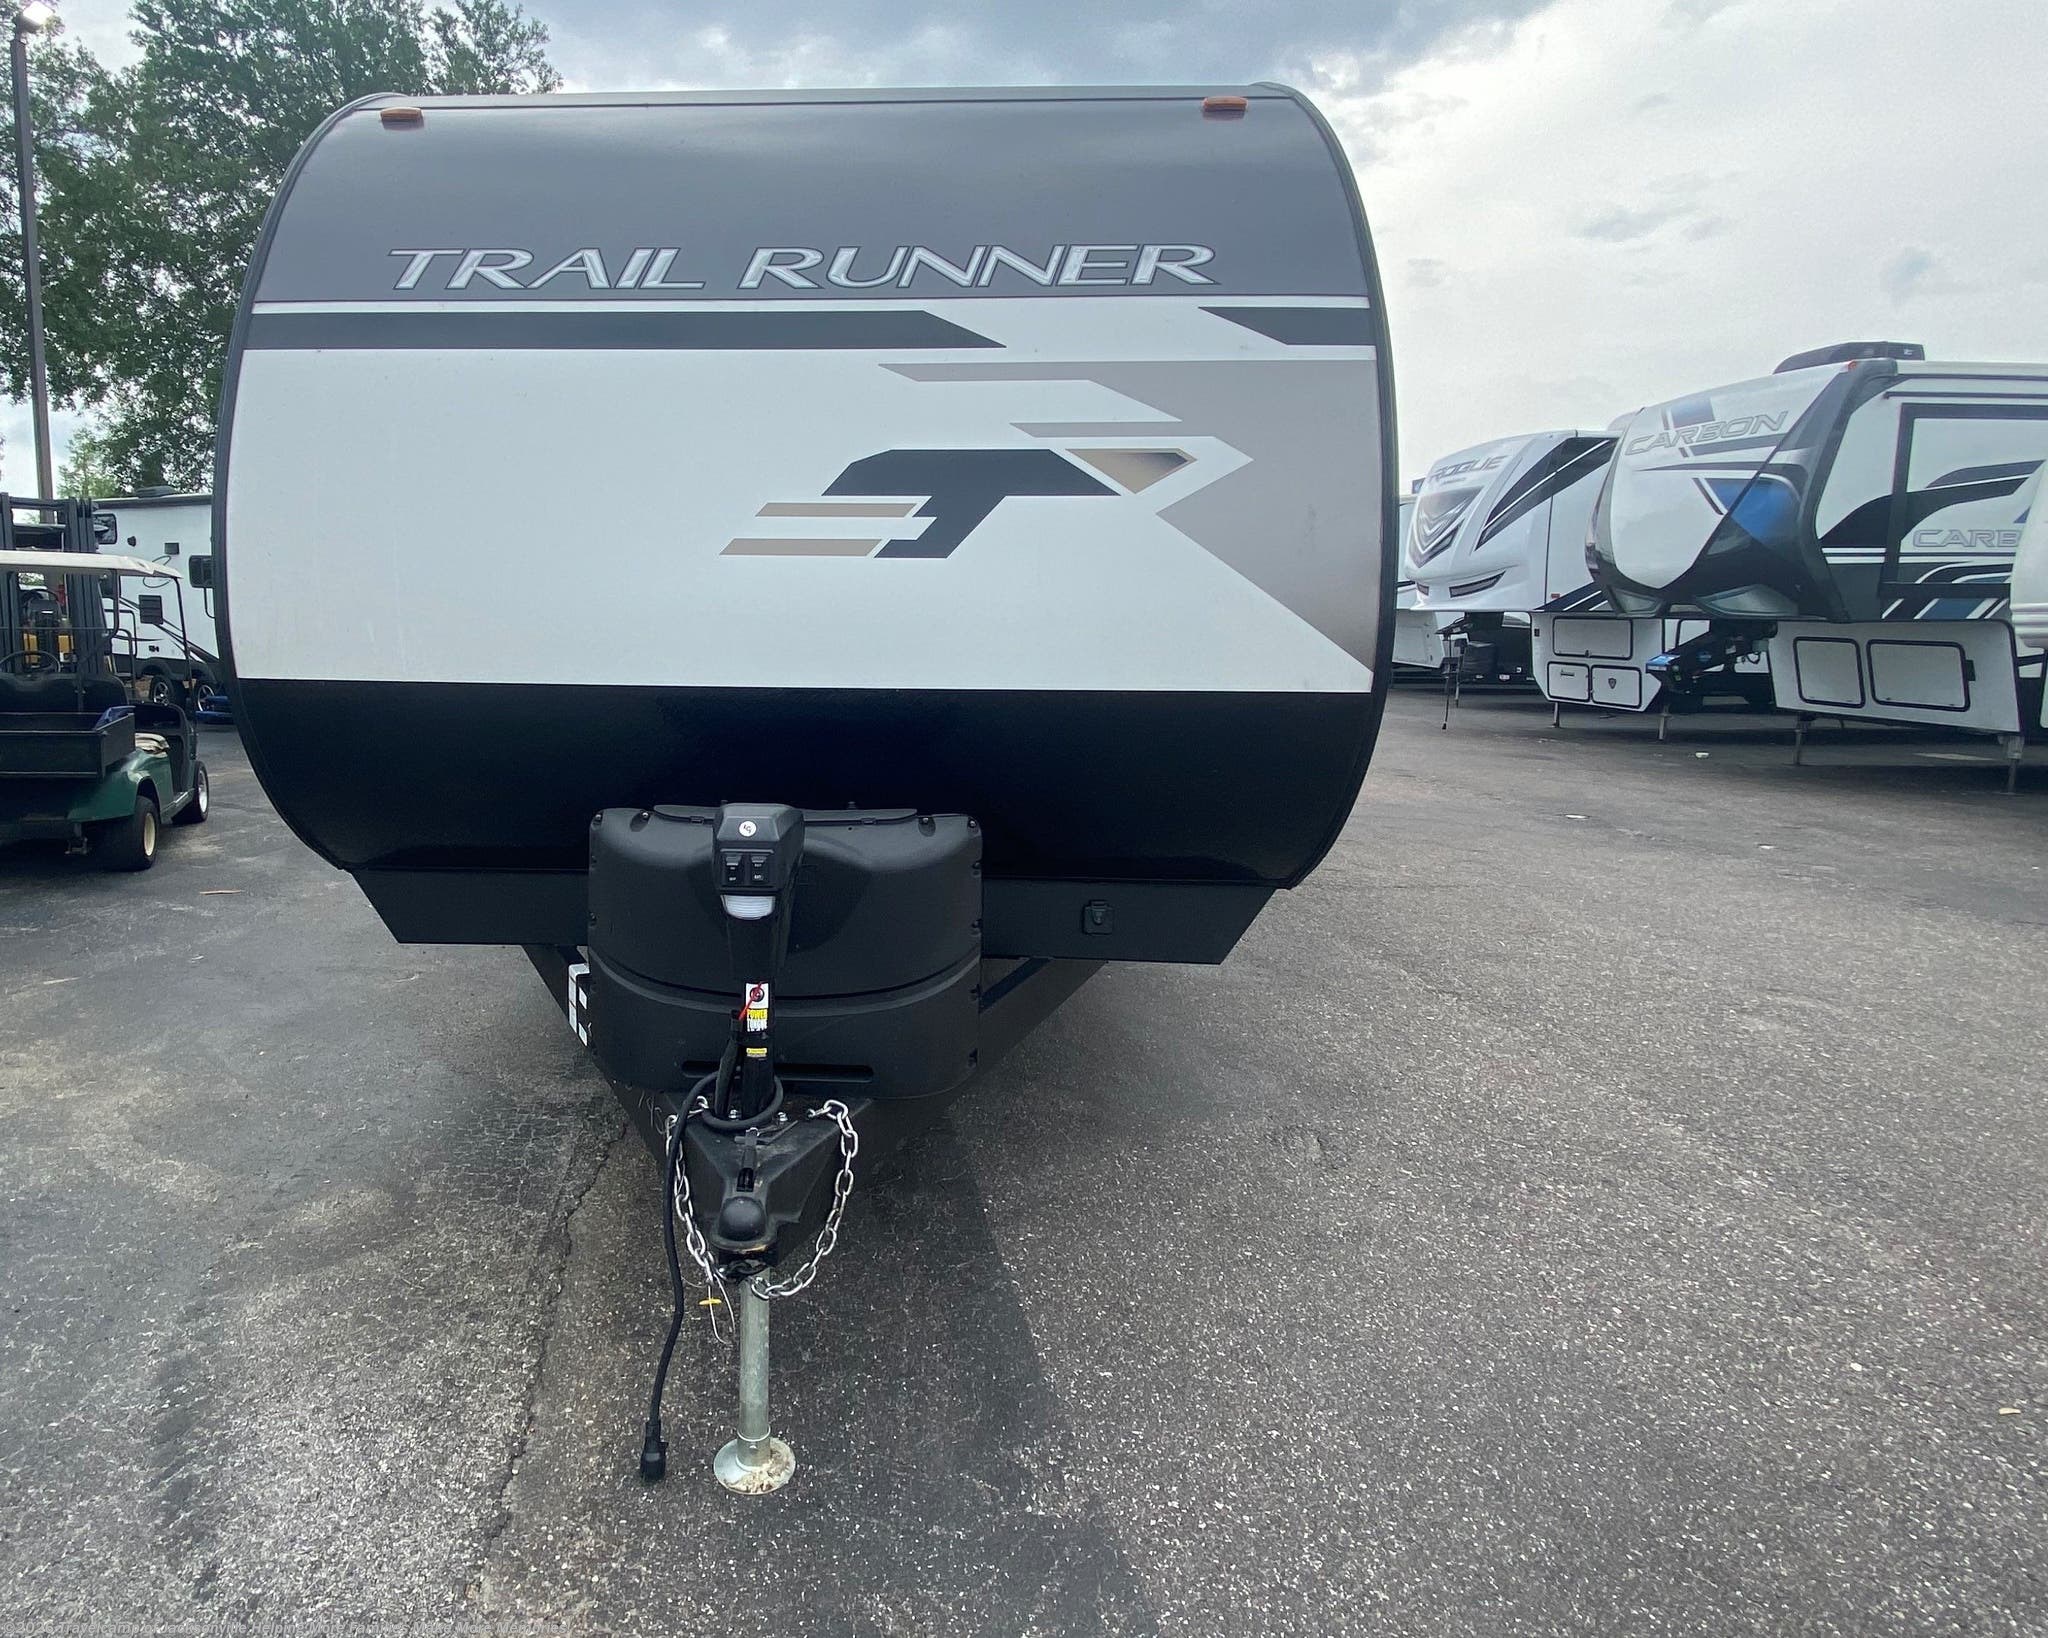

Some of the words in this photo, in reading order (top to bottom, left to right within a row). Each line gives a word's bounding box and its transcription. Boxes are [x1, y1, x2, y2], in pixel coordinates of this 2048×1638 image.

[388, 247, 706, 290] TRAIL
[736, 243, 1221, 290] RUNNER
[1625, 410, 1789, 456] CARBON
[1429, 454, 1510, 483] ROGUE
